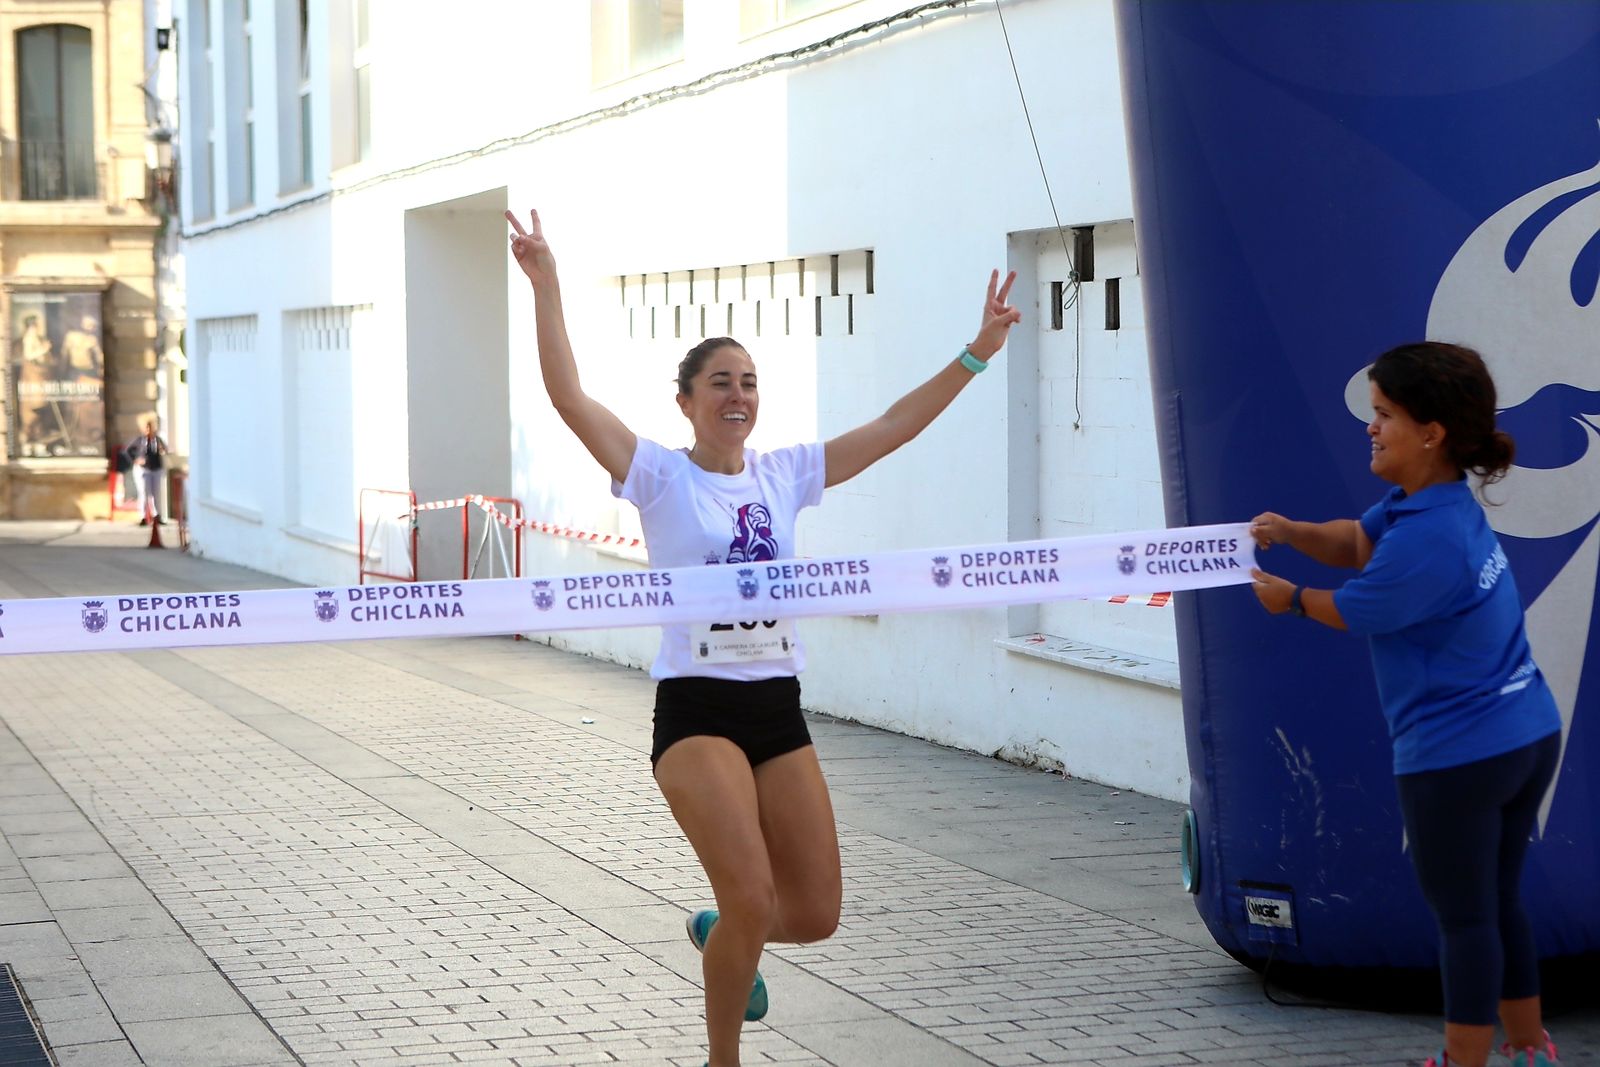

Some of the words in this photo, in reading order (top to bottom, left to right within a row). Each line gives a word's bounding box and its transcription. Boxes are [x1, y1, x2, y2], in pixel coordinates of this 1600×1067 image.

[1144, 538, 1239, 557] DEPORTES
[960, 549, 1060, 569] DEPORTES
[1145, 556, 1241, 576] CHICLANA
[765, 560, 870, 581] DEPORTES
[962, 568, 1060, 588] CHICLANA
[563, 572, 673, 592] DEPORTES
[769, 579, 872, 600] CHICLANA
[118, 593, 241, 612] DEPORTES
[348, 583, 463, 602] DEPORTES
[566, 591, 675, 610] CHICLANA
[120, 611, 242, 633] CHICLANA
[350, 602, 465, 622] CHICLANA
